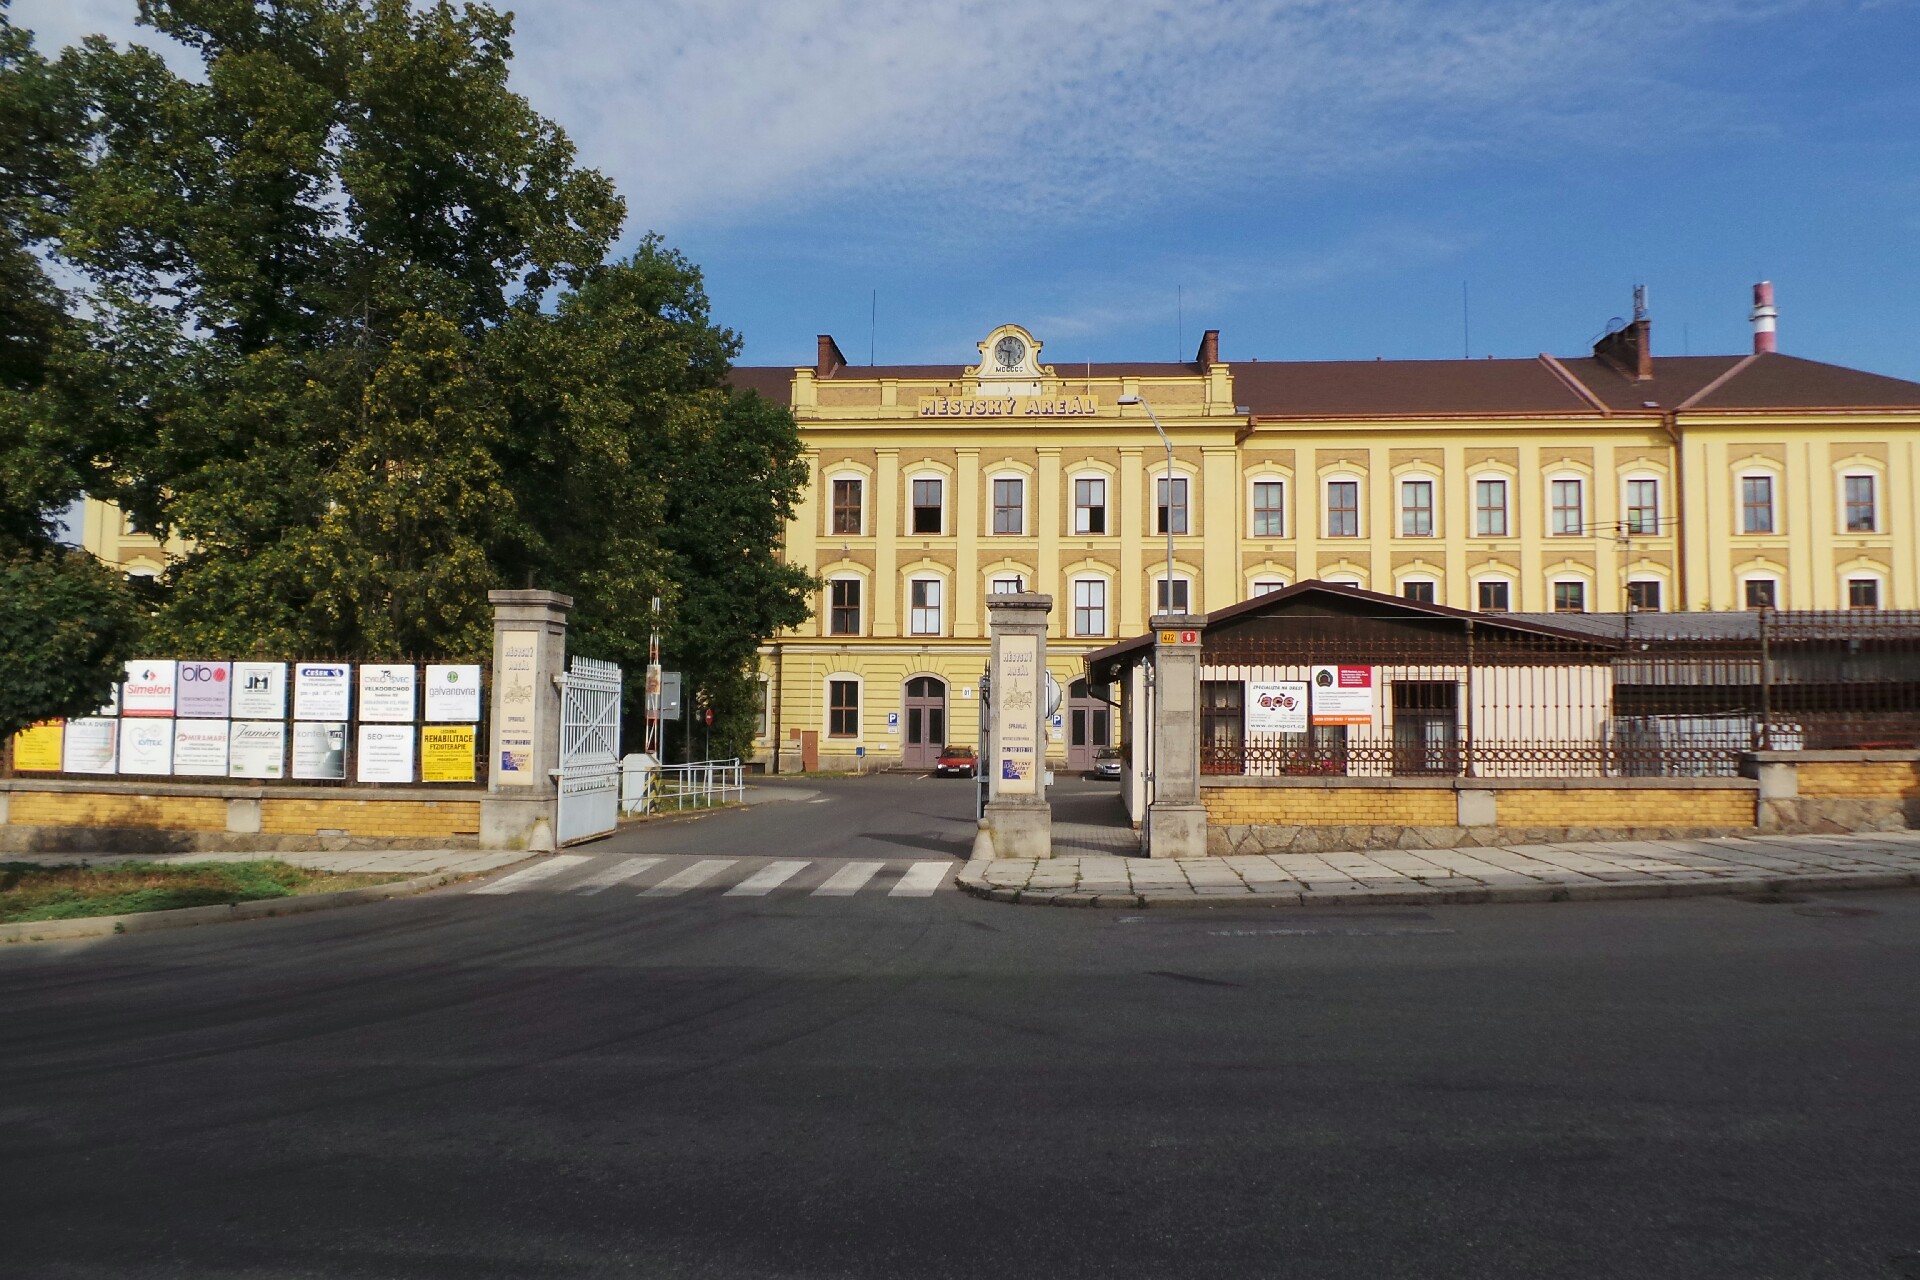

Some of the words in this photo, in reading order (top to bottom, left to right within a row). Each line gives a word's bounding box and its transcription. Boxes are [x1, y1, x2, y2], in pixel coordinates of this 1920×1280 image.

[921, 397, 1016, 415] MĚSTSKÝ
[1024, 397, 1096, 414] AREÁL
[128, 684, 171, 694] Simelon
[429, 686, 475, 698] galvanovna
[1261, 697, 1294, 707] ace
